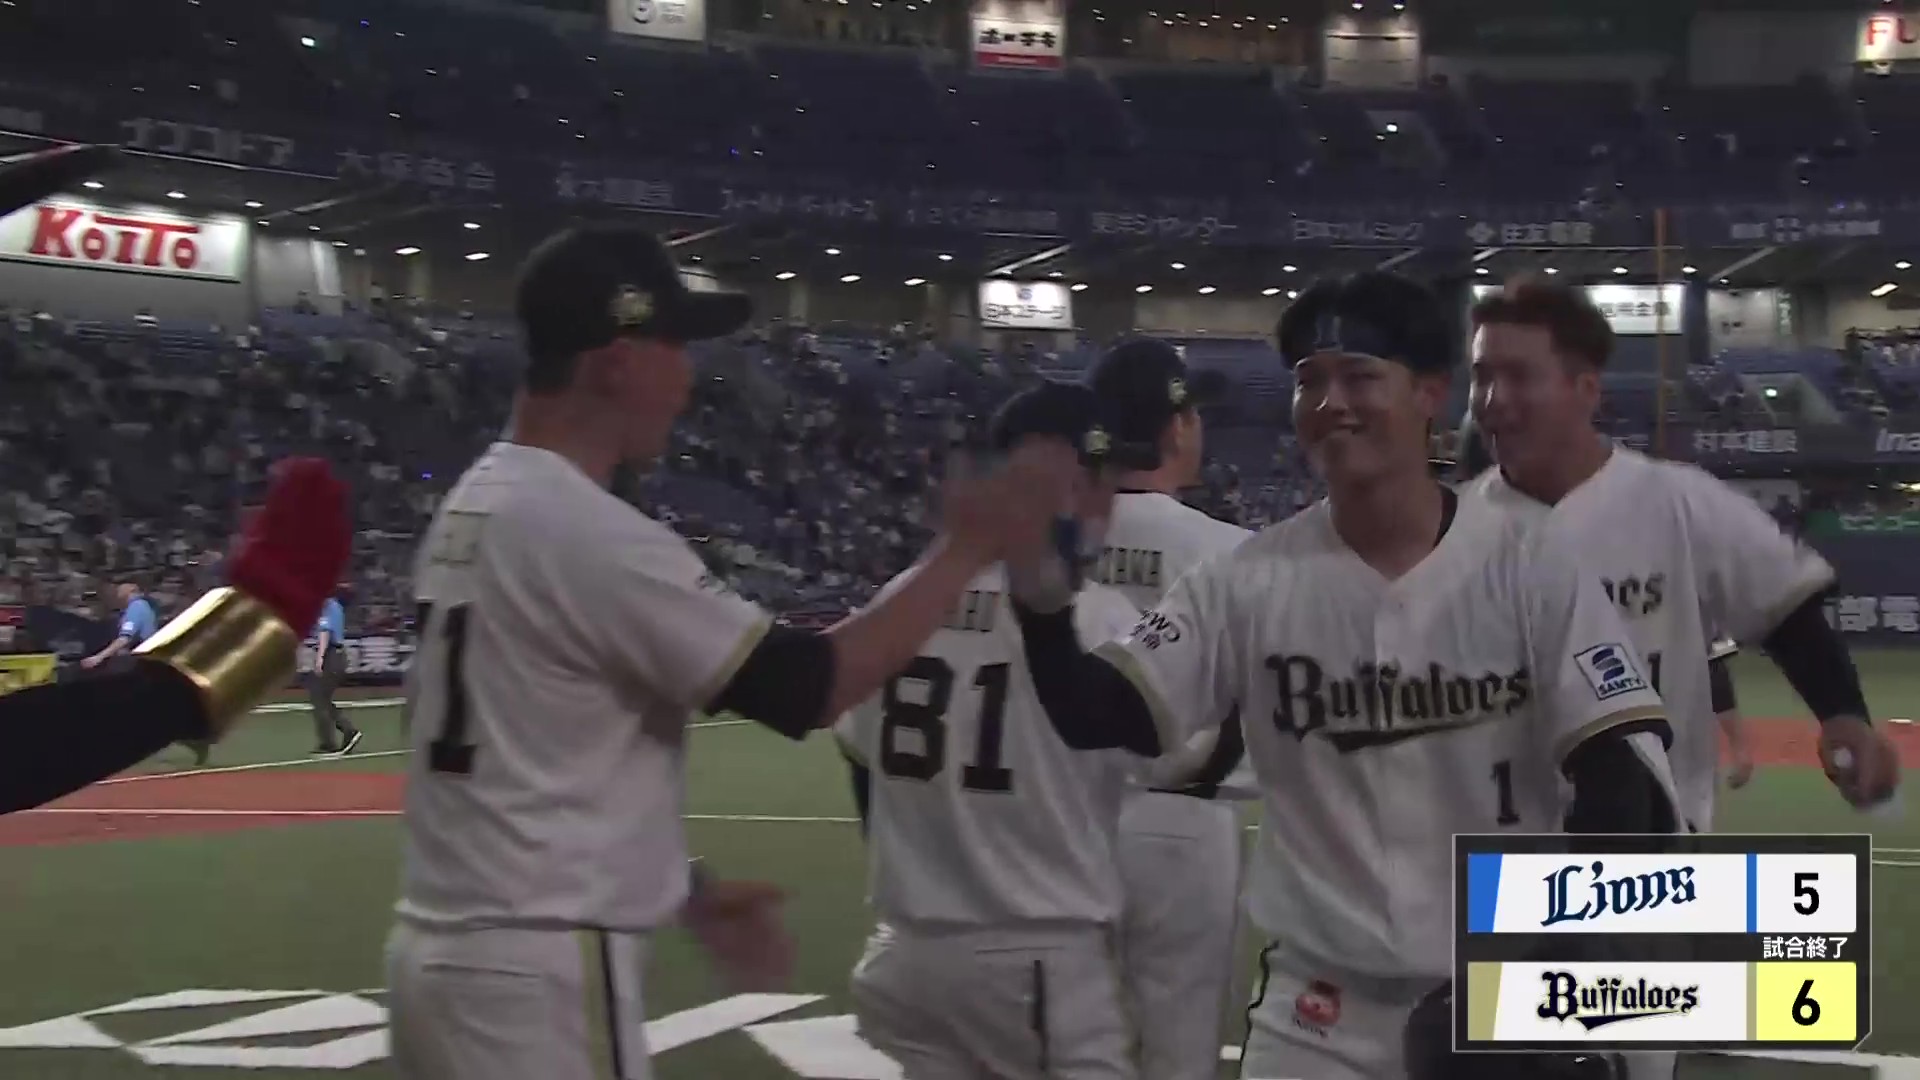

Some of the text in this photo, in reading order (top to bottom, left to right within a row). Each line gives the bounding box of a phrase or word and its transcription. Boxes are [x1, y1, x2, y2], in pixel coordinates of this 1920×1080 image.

[881, 656, 1014, 791] 81
[1265, 653, 1531, 738] Buffaloes
[1598, 676, 1642, 696] SAMTY
[1493, 759, 1521, 825] 1
